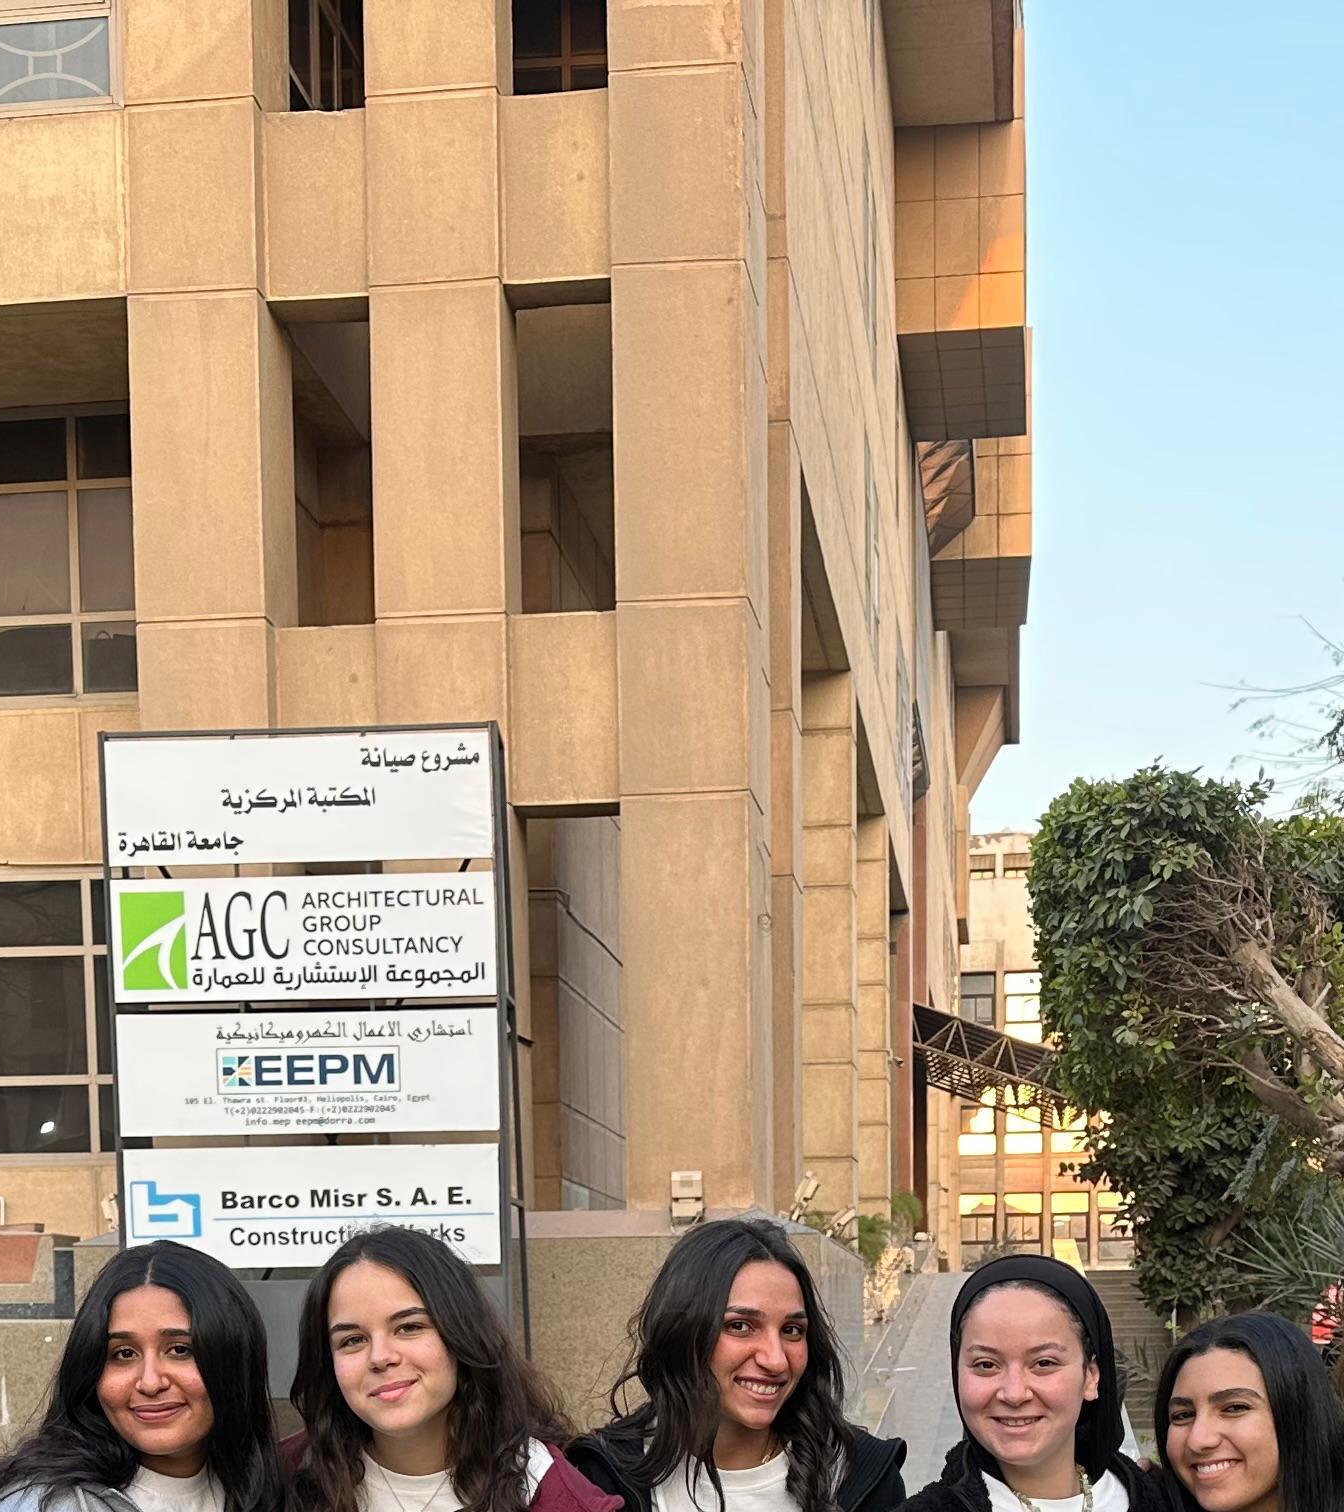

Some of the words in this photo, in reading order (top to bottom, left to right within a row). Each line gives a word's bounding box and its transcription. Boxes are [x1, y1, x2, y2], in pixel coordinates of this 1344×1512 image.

[359, 746, 416, 773] صيانة
[421, 742, 480, 773] مشروع
[220, 787, 302, 815] المركزية
[306, 786, 376, 813] المكتبة
[117, 831, 182, 857] القاهرة
[186, 829, 245, 856] جامعة
[301, 888, 484, 909] ARCHITECTURAL
[190, 890, 291, 961] AGC
[301, 914, 382, 933] GROUP
[302, 936, 464, 956] CONSULTANCY
[191, 966, 265, 992] للعمارة
[385, 961, 486, 989] المجموعة
[254, 1053, 396, 1087] EEPM
[221, 1190, 300, 1210] Barco
[310, 1189, 368, 1208] Misr
[375, 1187, 401, 1207] S.
[410, 1187, 438, 1206] A.
[447, 1186, 472, 1205] E.
